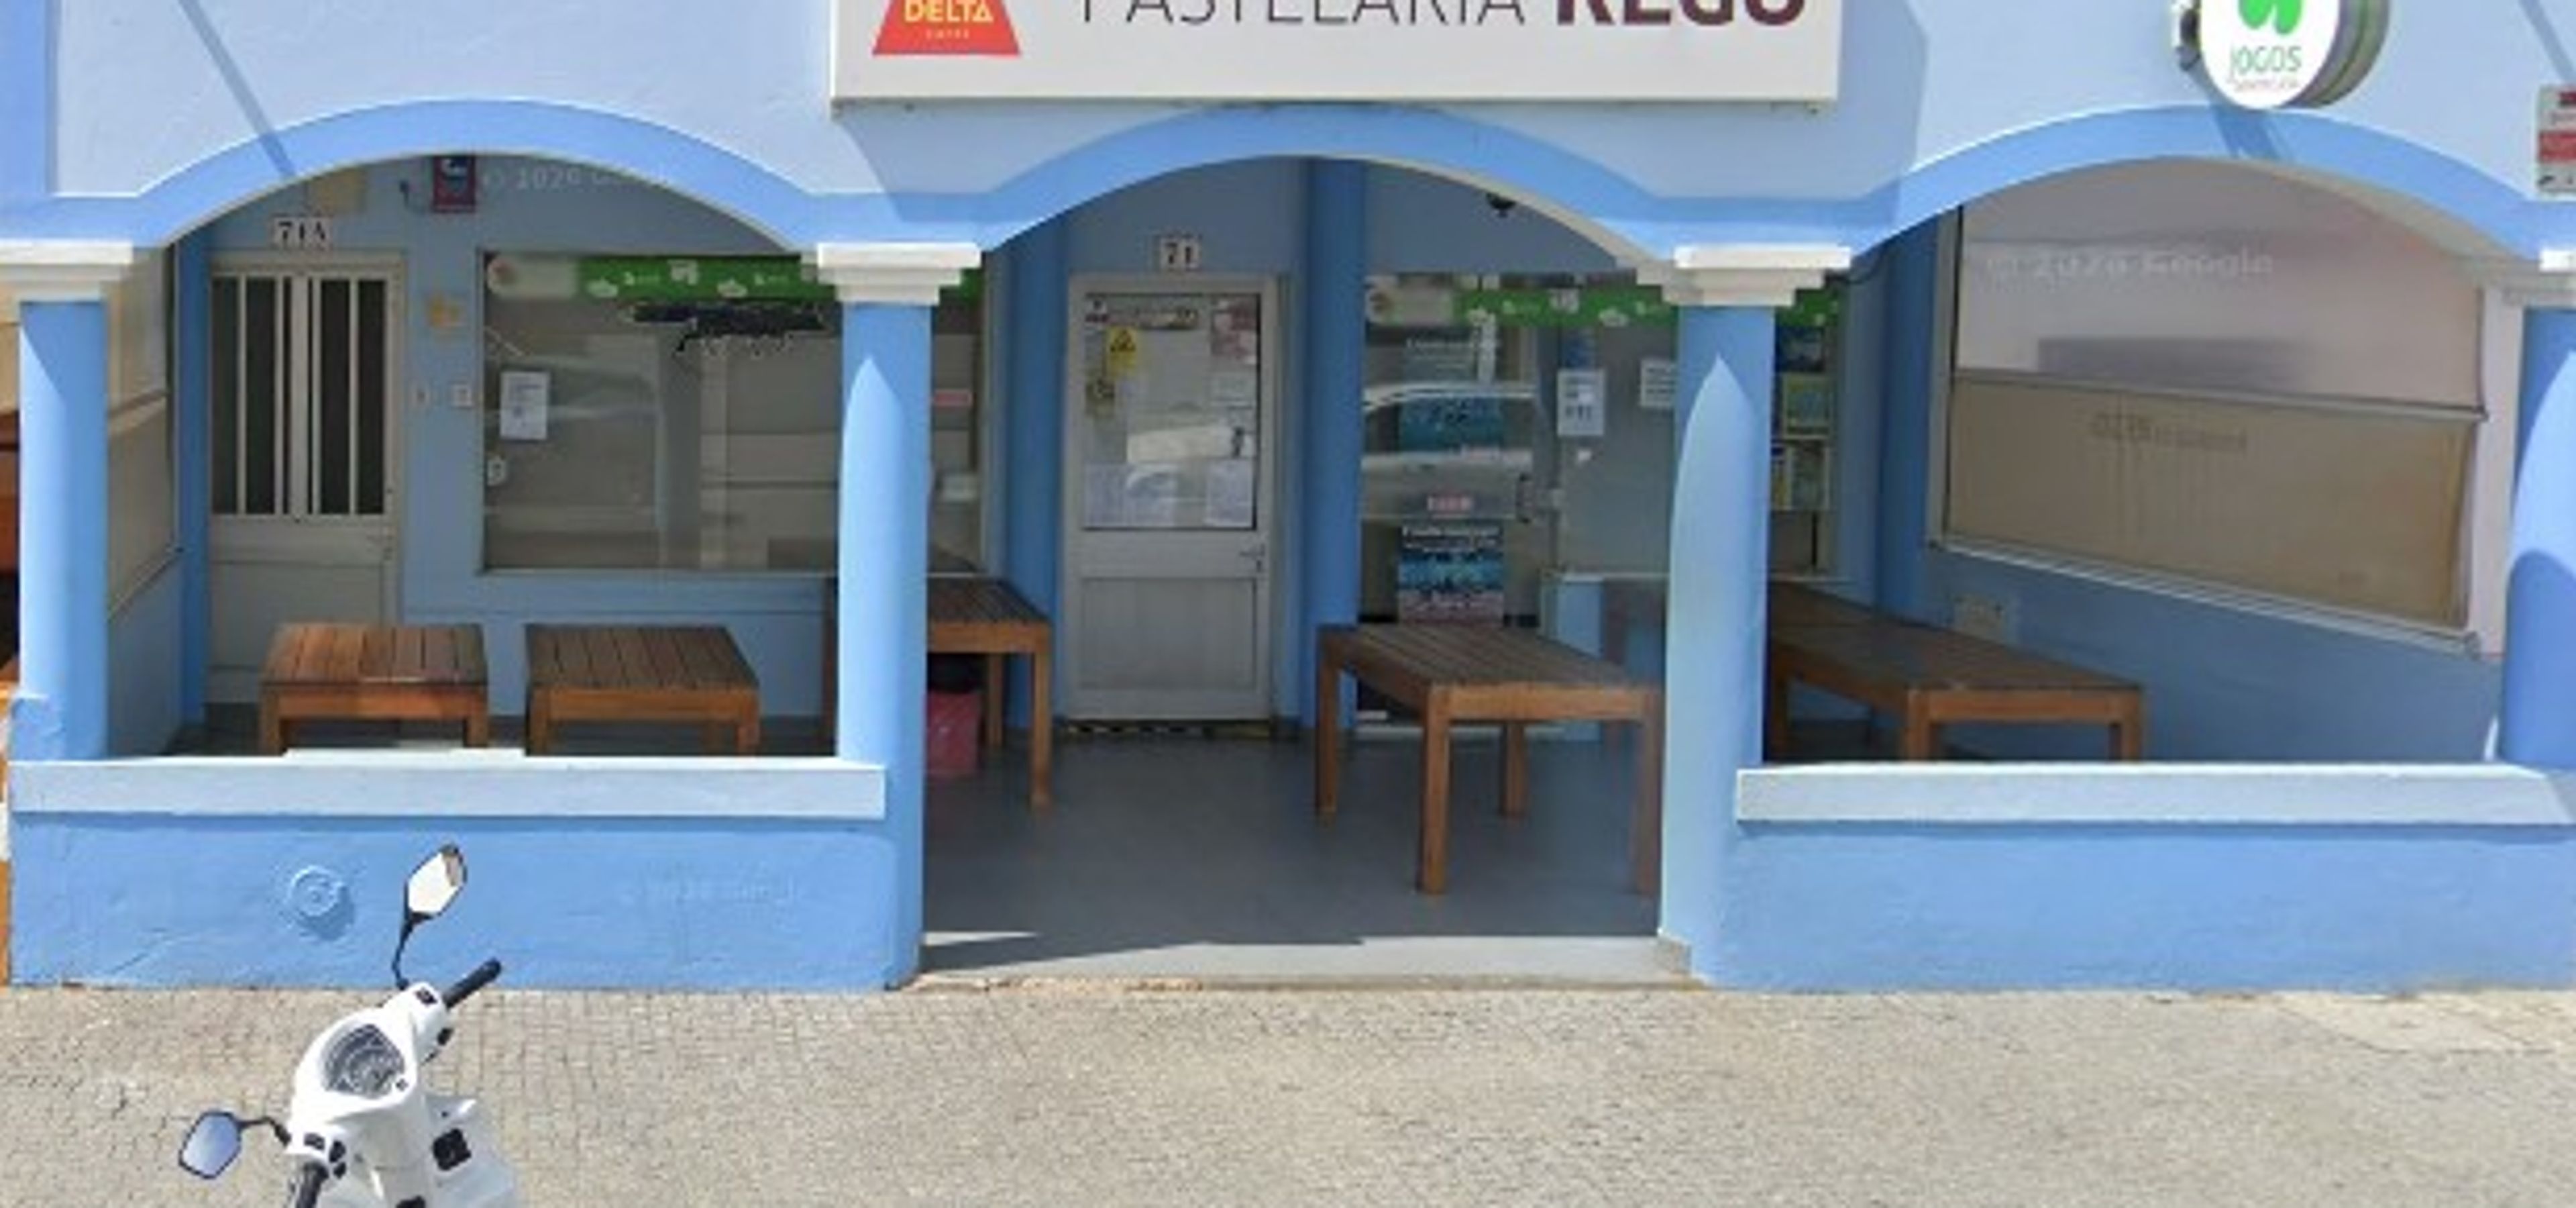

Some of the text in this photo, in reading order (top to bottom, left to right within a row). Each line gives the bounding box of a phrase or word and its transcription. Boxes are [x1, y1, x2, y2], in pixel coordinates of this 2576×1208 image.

[905, 0, 994, 22] DELTA
[277, 221, 326, 242] 71A
[1165, 242, 1191, 264] 71
